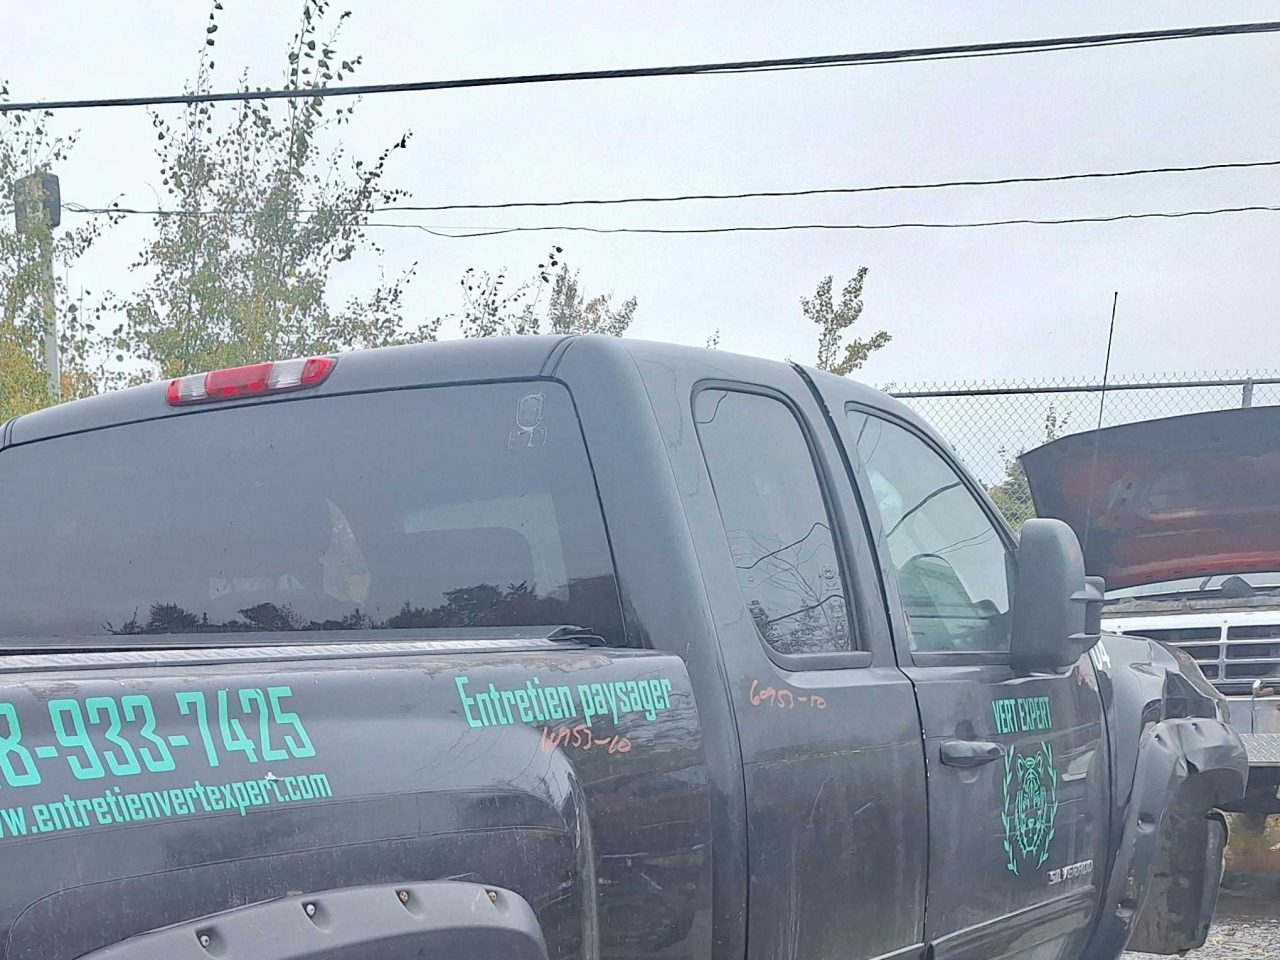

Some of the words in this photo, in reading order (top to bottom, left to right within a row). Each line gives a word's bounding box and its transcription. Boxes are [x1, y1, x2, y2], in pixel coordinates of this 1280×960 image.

[455, 676, 577, 728] Entretien
[583, 678, 672, 726] paysager
[992, 699, 1018, 734] VERT
[1018, 696, 1053, 732] EXPERT
